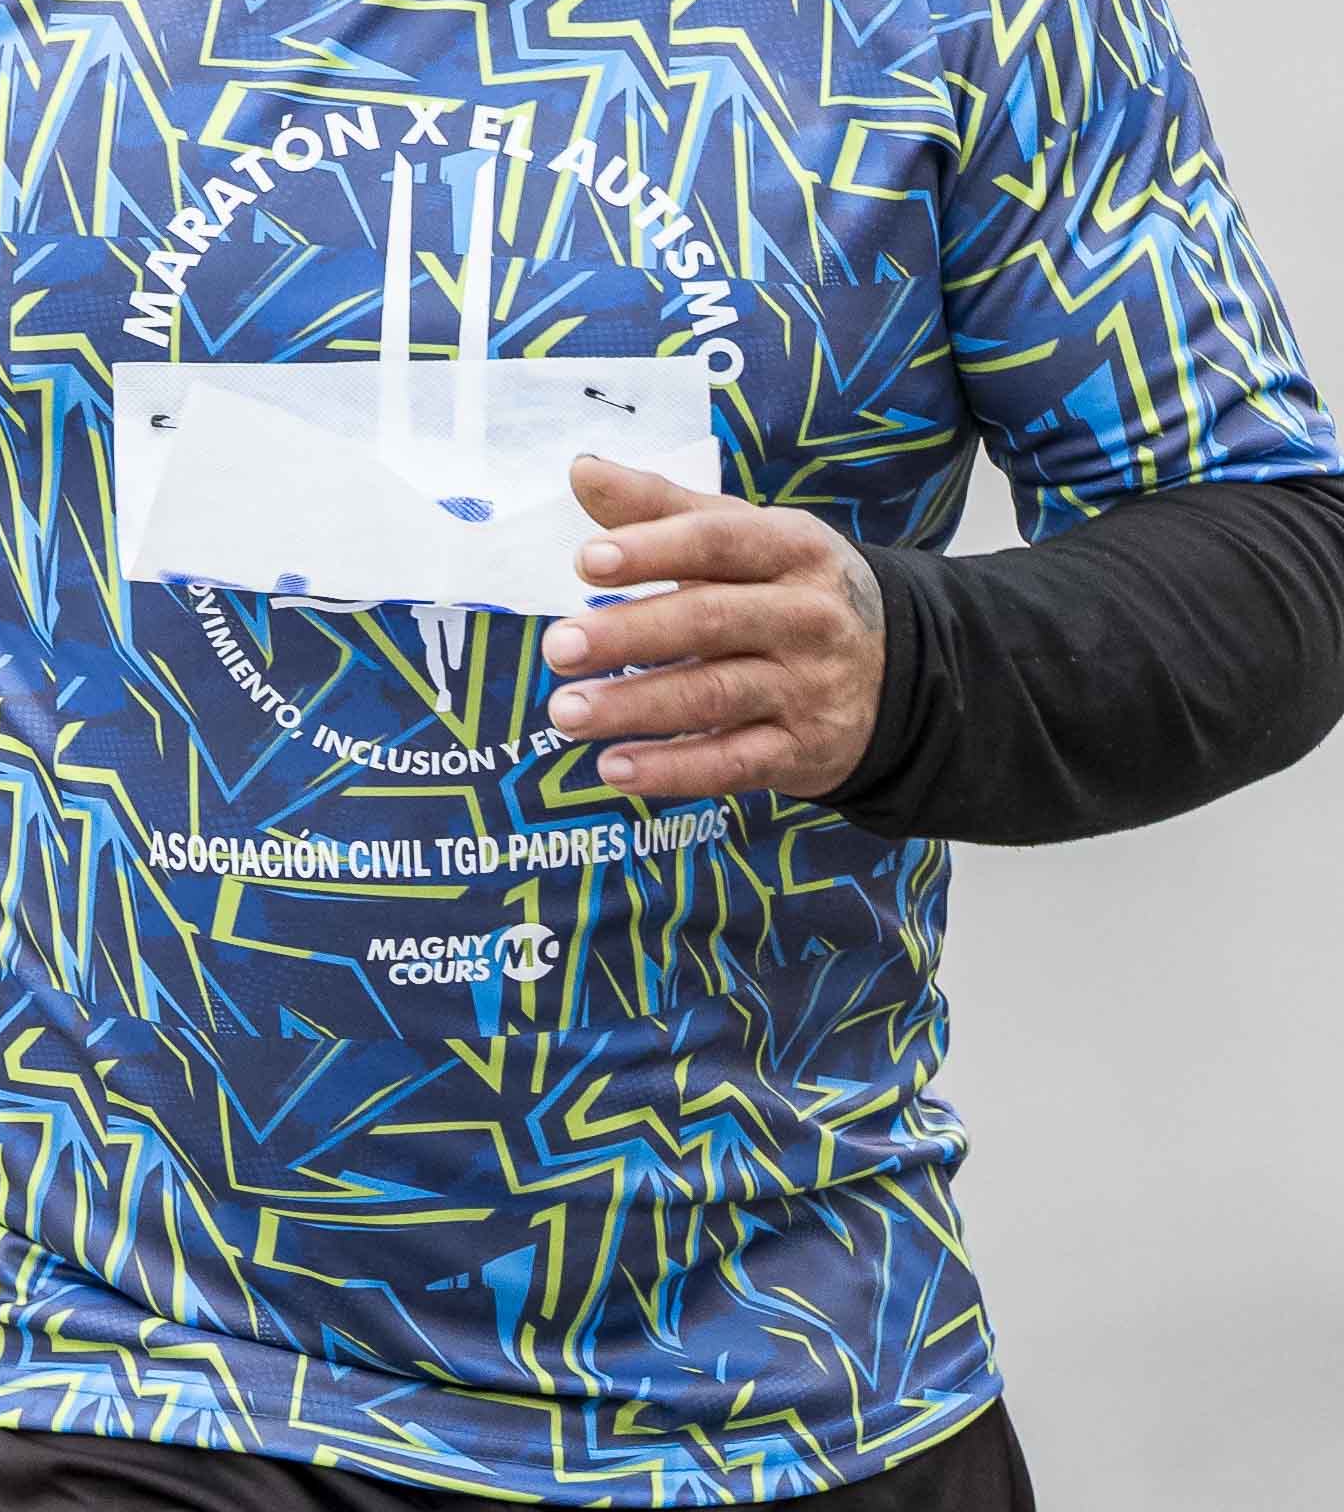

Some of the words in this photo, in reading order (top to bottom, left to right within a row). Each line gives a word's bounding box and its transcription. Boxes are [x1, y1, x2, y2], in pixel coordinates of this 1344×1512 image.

[122, 105, 381, 348] MARATÓN
[401, 102, 449, 145] X
[468, 104, 534, 162] EL
[546, 138, 745, 385] AUTISMO
[311, 724, 496, 775] INCLUSIÓN
[499, 738, 522, 764] Y
[149, 828, 340, 878] ASOCIACIÓN
[348, 839, 431, 879] CIVIL
[435, 834, 499, 876] TGD
[508, 823, 626, 872] PADRES
[634, 805, 730, 857] UNIDOS
[367, 934, 491, 961] MAGNY
[388, 958, 490, 985] COURS
